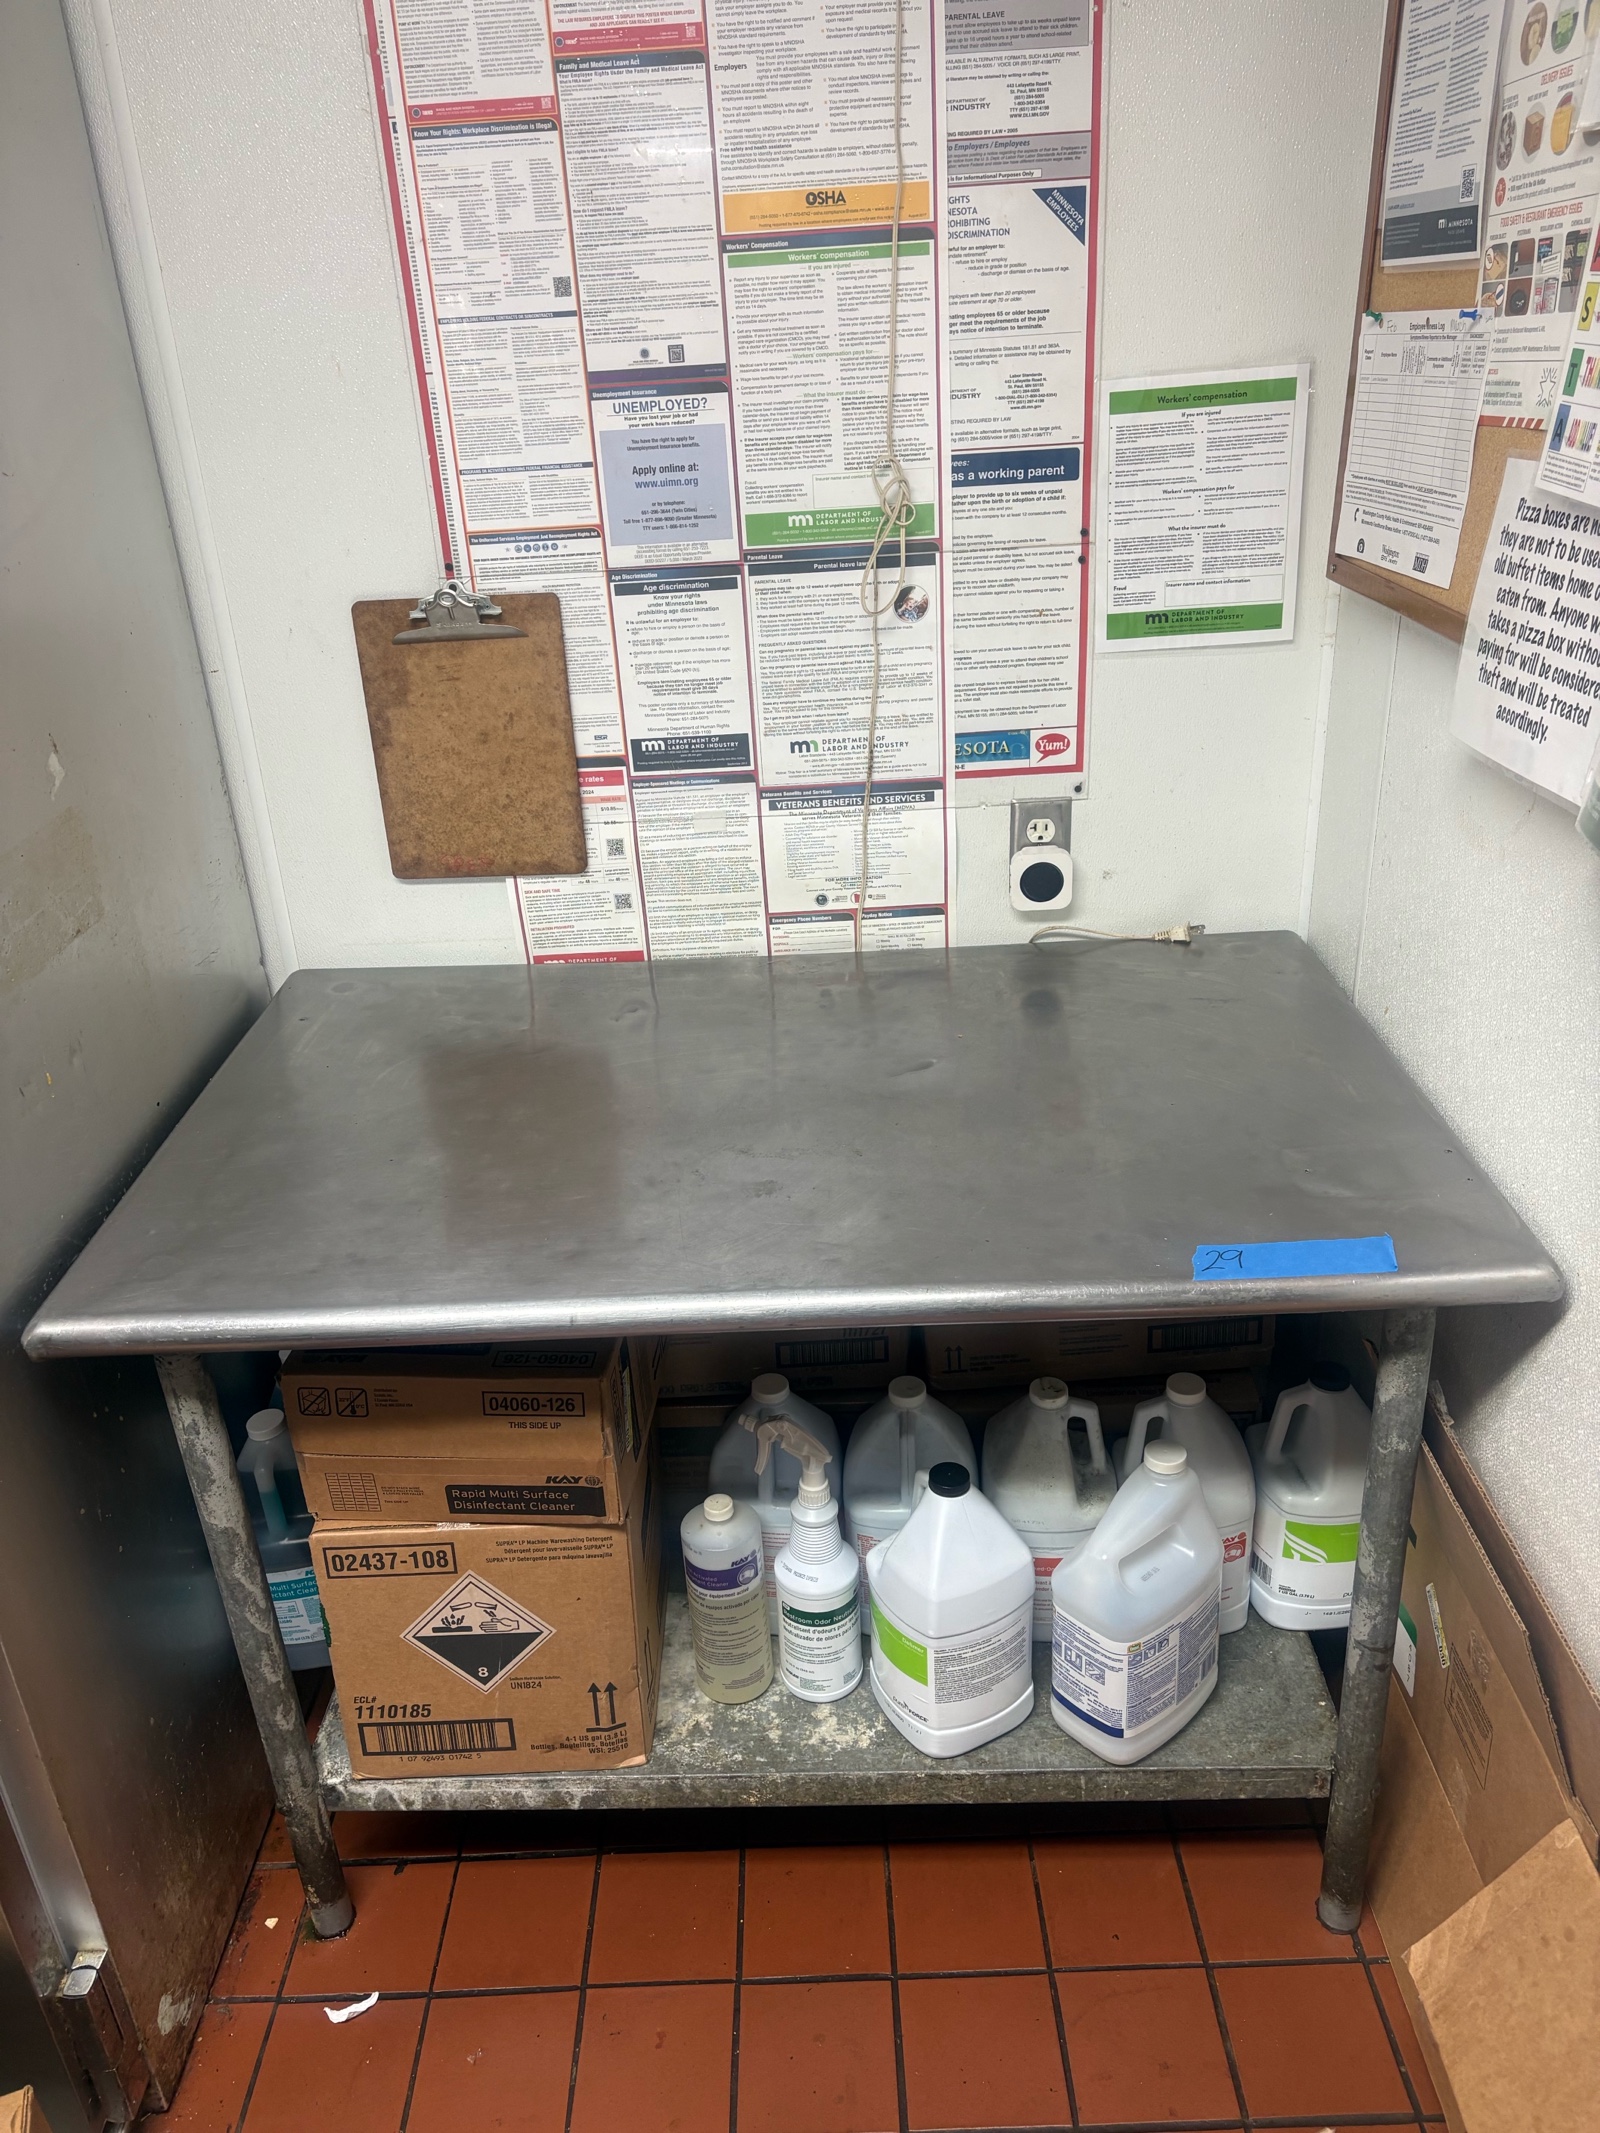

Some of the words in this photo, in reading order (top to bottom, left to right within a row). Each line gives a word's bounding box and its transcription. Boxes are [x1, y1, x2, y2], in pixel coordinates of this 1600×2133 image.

[714, 63, 747, 72] Employers
[950, 102, 990, 112] INDUSTRY
[462, 126, 489, 134] Workplace
[491, 123, 528, 132] Discrimination
[805, 191, 846, 206] OSHA
[1046, 196, 1080, 232] EMPLOYEES
[1052, 189, 1085, 226] MINNESOTA
[948, 218, 990, 228] OHIBITING
[788, 252, 819, 262] Workers'
[820, 249, 869, 260] compensation
[1581, 296, 1592, 323] S
[592, 390, 631, 398] Unemployment
[1158, 394, 1191, 403] Workers'
[1193, 390, 1247, 403] compensation
[613, 397, 708, 414] UNEMPLOYED?
[632, 465, 657, 477] Apply
[659, 463, 685, 474] online
[688, 462, 699, 472] at:
[952, 473, 964, 481] as
[968, 472, 975, 480] a
[978, 467, 1024, 480] working
[1028, 465, 1065, 478] parent
[635, 477, 699, 490] www.uimn.org
[1515, 497, 1541, 524] Pizza
[1542, 504, 1571, 530] boxes
[1571, 514, 1591, 533] are
[1590, 519, 1600, 536] no
[1500, 524, 1520, 552] they
[1518, 534, 1535, 552] are
[1534, 537, 1555, 557] not
[1554, 538, 1567, 560] to
[1567, 540, 1582, 563] be
[1494, 552, 1508, 575] old
[1506, 556, 1537, 583] buffet
[1535, 563, 1566, 591] items
[1566, 569, 1594, 599] home
[643, 583, 657, 592] Age
[659, 581, 709, 590] discrimination
[1496, 586, 1521, 608] eaten
[1521, 588, 1547, 617] from.
[1549, 597, 1589, 628] Anyone
[1488, 610, 1510, 635] takes
[1510, 622, 1517, 637] a
[1516, 620, 1545, 647] pizza
[1546, 628, 1566, 654] box
[1477, 638, 1504, 665] paying
[1504, 642, 1519, 667] for
[1520, 652, 1540, 676] will
[1538, 657, 1552, 680] be
[1552, 667, 1600, 701] considere
[1478, 662, 1501, 689] theft
[1500, 677, 1518, 696] and
[1517, 682, 1538, 705] will
[1536, 687, 1549, 710] be
[1549, 694, 1592, 727] treated
[1496, 705, 1548, 744] accordingly.
[955, 740, 1011, 757] ESOTA
[1038, 738, 1068, 751] Yum!
[776, 800, 821, 810] VETERANS
[823, 797, 862, 807] BENEFITS
[869, 796, 883, 805] ND
[885, 794, 926, 803] SERVICES
[1201, 1249, 1244, 1272] 29
[489, 1396, 576, 1412] 04060-126
[508, 1421, 527, 1429] THIS
[545, 1475, 584, 1484] KAY
[452, 1490, 486, 1499] Rapid
[490, 1490, 519, 1499] Multi
[523, 1490, 569, 1499] Surface
[454, 1501, 526, 1510] Disinfectant
[530, 1502, 575, 1511] Cleaner
[331, 1549, 449, 1573] 02437-108
[731, 1555, 750, 1568] KAY
[291, 1580, 316, 1590] Surfac
[784, 1609, 812, 1625] Restroom
[477, 1666, 489, 1678] 8
[510, 1681, 542, 1690] UN1824
[354, 1696, 377, 1704] ECL#
[354, 1704, 432, 1719] 1110185
[600, 1737, 628, 1747] Botellas
[604, 1732, 618, 1741] (3.8
[608, 1743, 628, 1753] 25510
